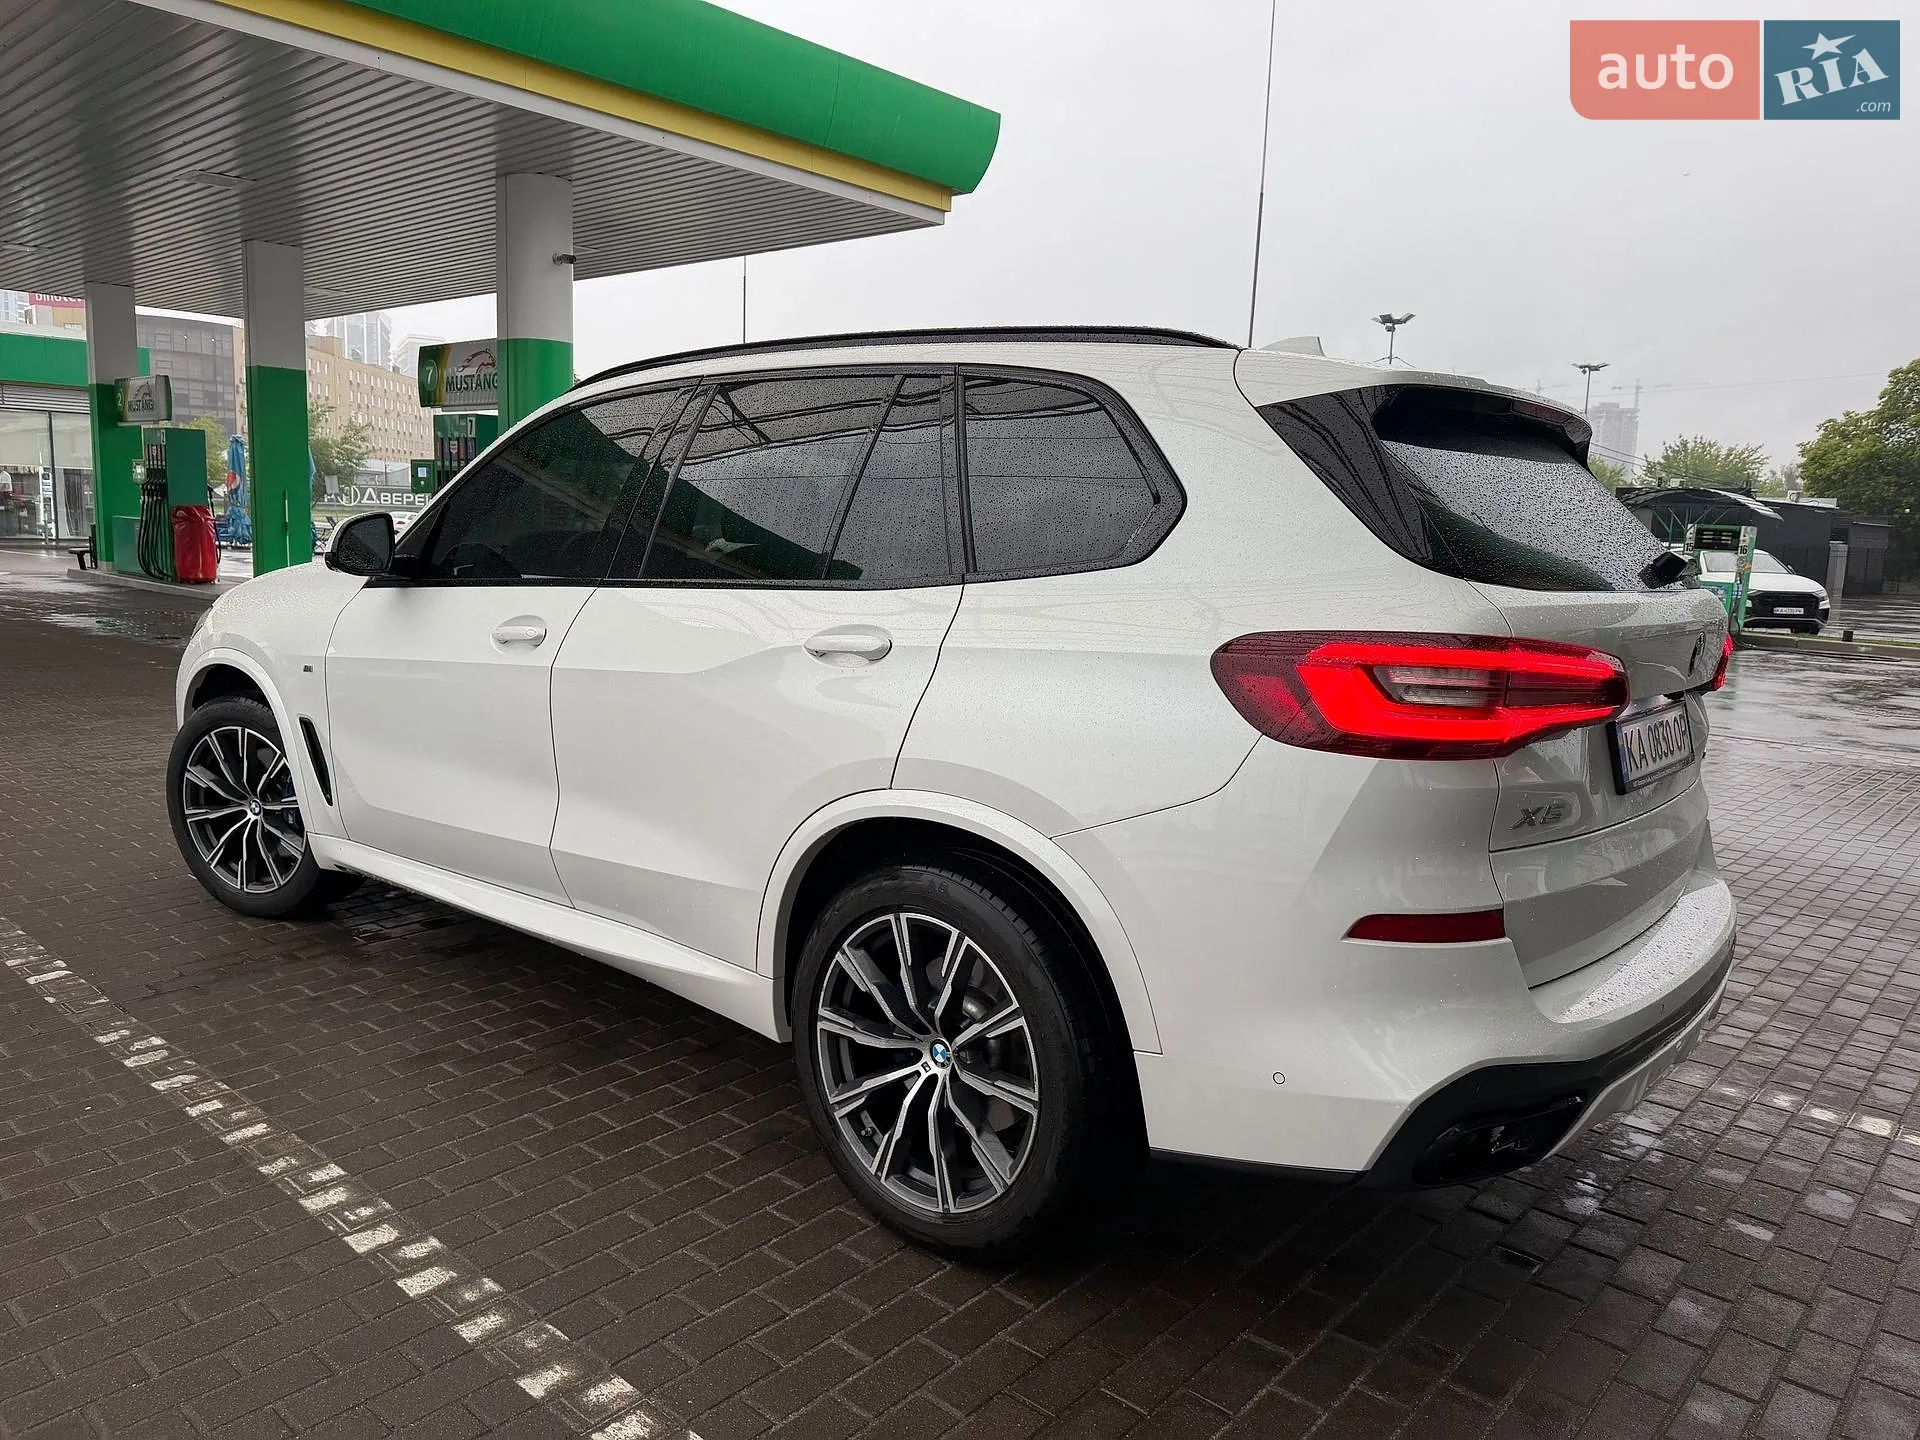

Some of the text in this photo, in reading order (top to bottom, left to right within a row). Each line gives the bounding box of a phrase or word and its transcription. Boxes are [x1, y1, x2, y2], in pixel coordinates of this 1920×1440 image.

[425, 365, 435, 385] 7
[1685, 542, 1694, 552] 15
[1739, 544, 1749, 555] 16
